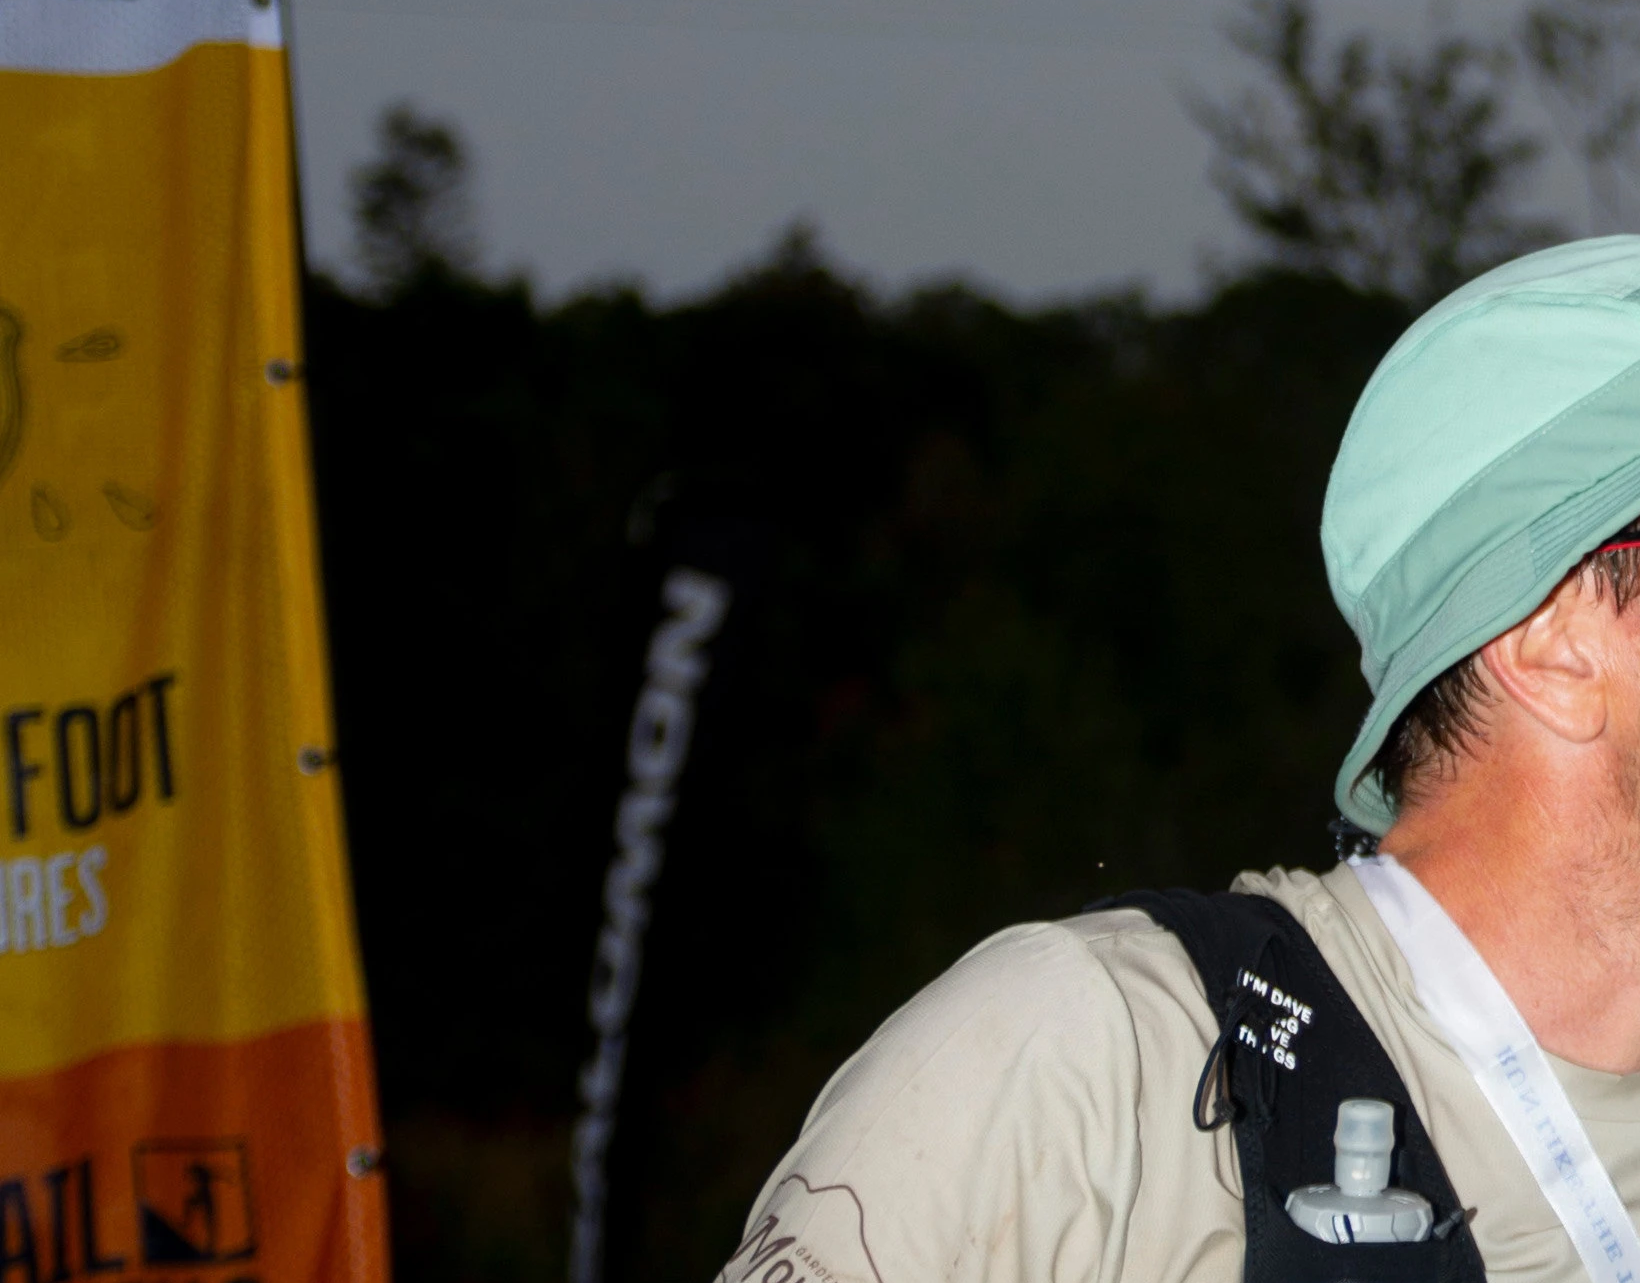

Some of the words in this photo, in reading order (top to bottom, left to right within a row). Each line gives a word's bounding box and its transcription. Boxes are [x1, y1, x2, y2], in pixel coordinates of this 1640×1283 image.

[4, 675, 176, 839] FOOT
[1242, 969, 1268, 997] I'M
[1270, 987, 1314, 1025] DAVE
